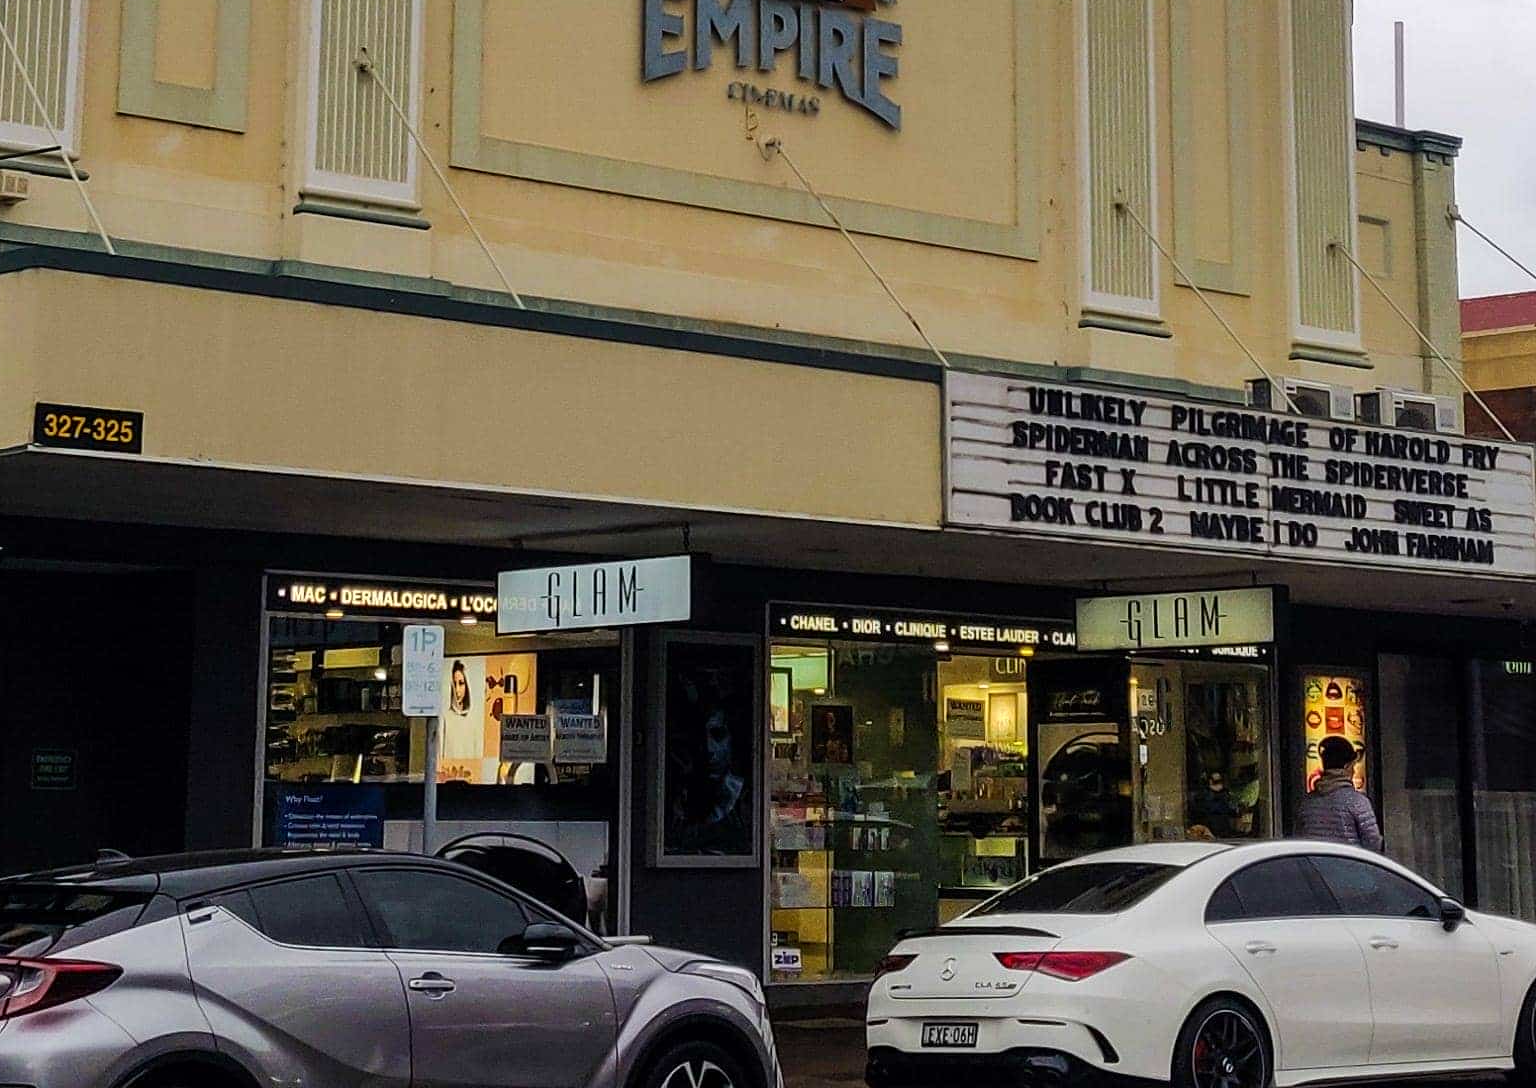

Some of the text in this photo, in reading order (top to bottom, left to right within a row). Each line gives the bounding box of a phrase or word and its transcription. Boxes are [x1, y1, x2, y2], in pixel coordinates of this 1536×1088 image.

[728, 81, 820, 113] CINEMAS
[44, 413, 134, 443] 327-325
[1028, 386, 1499, 470] UNLIKELY PILGRIMAGE OF HAROLD FRY
[1013, 420, 1469, 498] SPIDERMAN ACROSS THE SPIDERVERSE
[1046, 460, 1492, 532] FAST X LITTLE MERMAID SWEET AS
[1010, 492, 1495, 565] BOOK CLUB 2 MAYBE I DO JOHN FARNHAM
[290, 585, 326, 604] MAC
[340, 588, 448, 610] DERMALOGICA
[540, 565, 644, 627] GLAM
[1120, 595, 1228, 648] GLAM
[790, 614, 839, 632] CHANEL
[852, 618, 881, 635] DIOR
[895, 621, 947, 638] CLINIQUE
[960, 625, 995, 641] ESTEE
[996, 628, 1039, 644] LAUDER
[506, 718, 545, 729] WANTED
